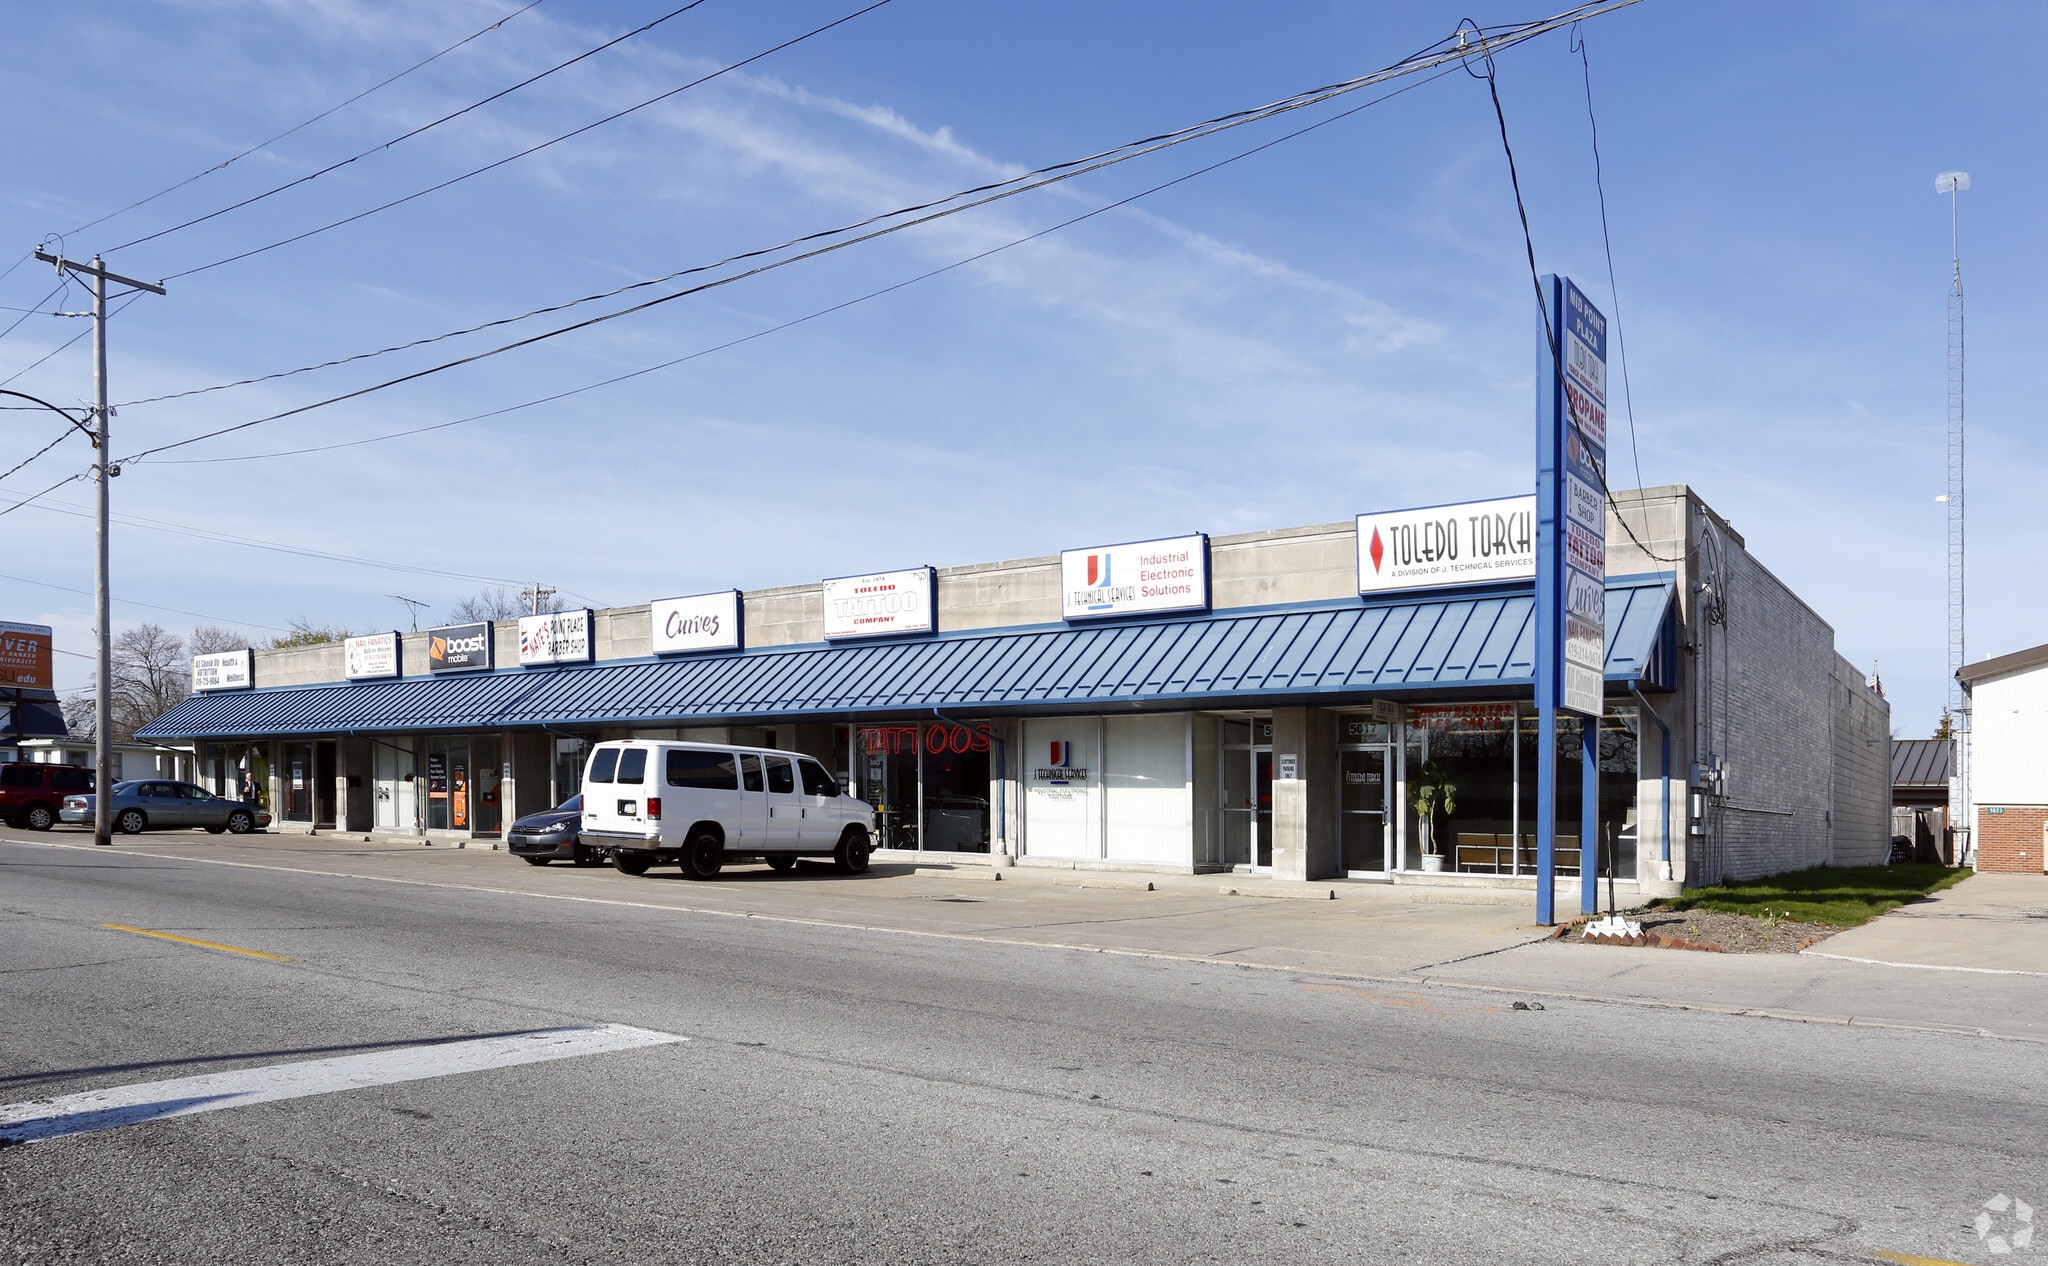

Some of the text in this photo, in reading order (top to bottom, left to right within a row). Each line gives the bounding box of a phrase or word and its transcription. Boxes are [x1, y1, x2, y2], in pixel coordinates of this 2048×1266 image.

[1570, 287, 1603, 337] MID POINT
[1576, 316, 1597, 351] PLAZA
[1567, 382, 1604, 433] PROPANE
[1573, 482, 1597, 511] BARBER
[1577, 502, 1594, 525] SHOP
[1390, 511, 1531, 566] TOLEDO TORCH
[1570, 522, 1599, 549] TOLEDO
[1140, 551, 1188, 565] Industrial
[1567, 531, 1602, 570] TATTOO
[1141, 567, 1194, 581] Electronic
[1398, 568, 1428, 576] DIVISION
[1451, 562, 1492, 572] TECHNICAL
[1495, 558, 1533, 568] SERVICES
[1570, 553, 1599, 578] COMPANY
[854, 584, 896, 594] TOLEDO
[1074, 587, 1105, 606] TECHNICAL
[1108, 586, 1136, 603] SERVICES
[1142, 585, 1191, 597] Solutions
[1567, 571, 1604, 621] Curves
[833, 591, 917, 618] TATTOO
[550, 617, 583, 635] POINT PLACE
[666, 610, 719, 638] Curves
[854, 616, 895, 624] COMPANY
[355, 636, 392, 648] NAIL FANATICS
[447, 633, 485, 653] boost
[529, 622, 549, 658] NATE'S
[548, 639, 585, 656] BARBER SHOP
[448, 655, 468, 664] mobile
[226, 674, 244, 682] Wellness
[1412, 704, 1511, 718] TORCH REPAIRS
[1350, 724, 1376, 734] 5017
[1412, 717, 1501, 730] SALES PARTS
[860, 724, 990, 755] TATTOOS
[1038, 768, 1064, 780] TECHNICAL
[1065, 768, 1088, 780] SERVICES
[1350, 773, 1380, 782] TOLEDO TORCH
